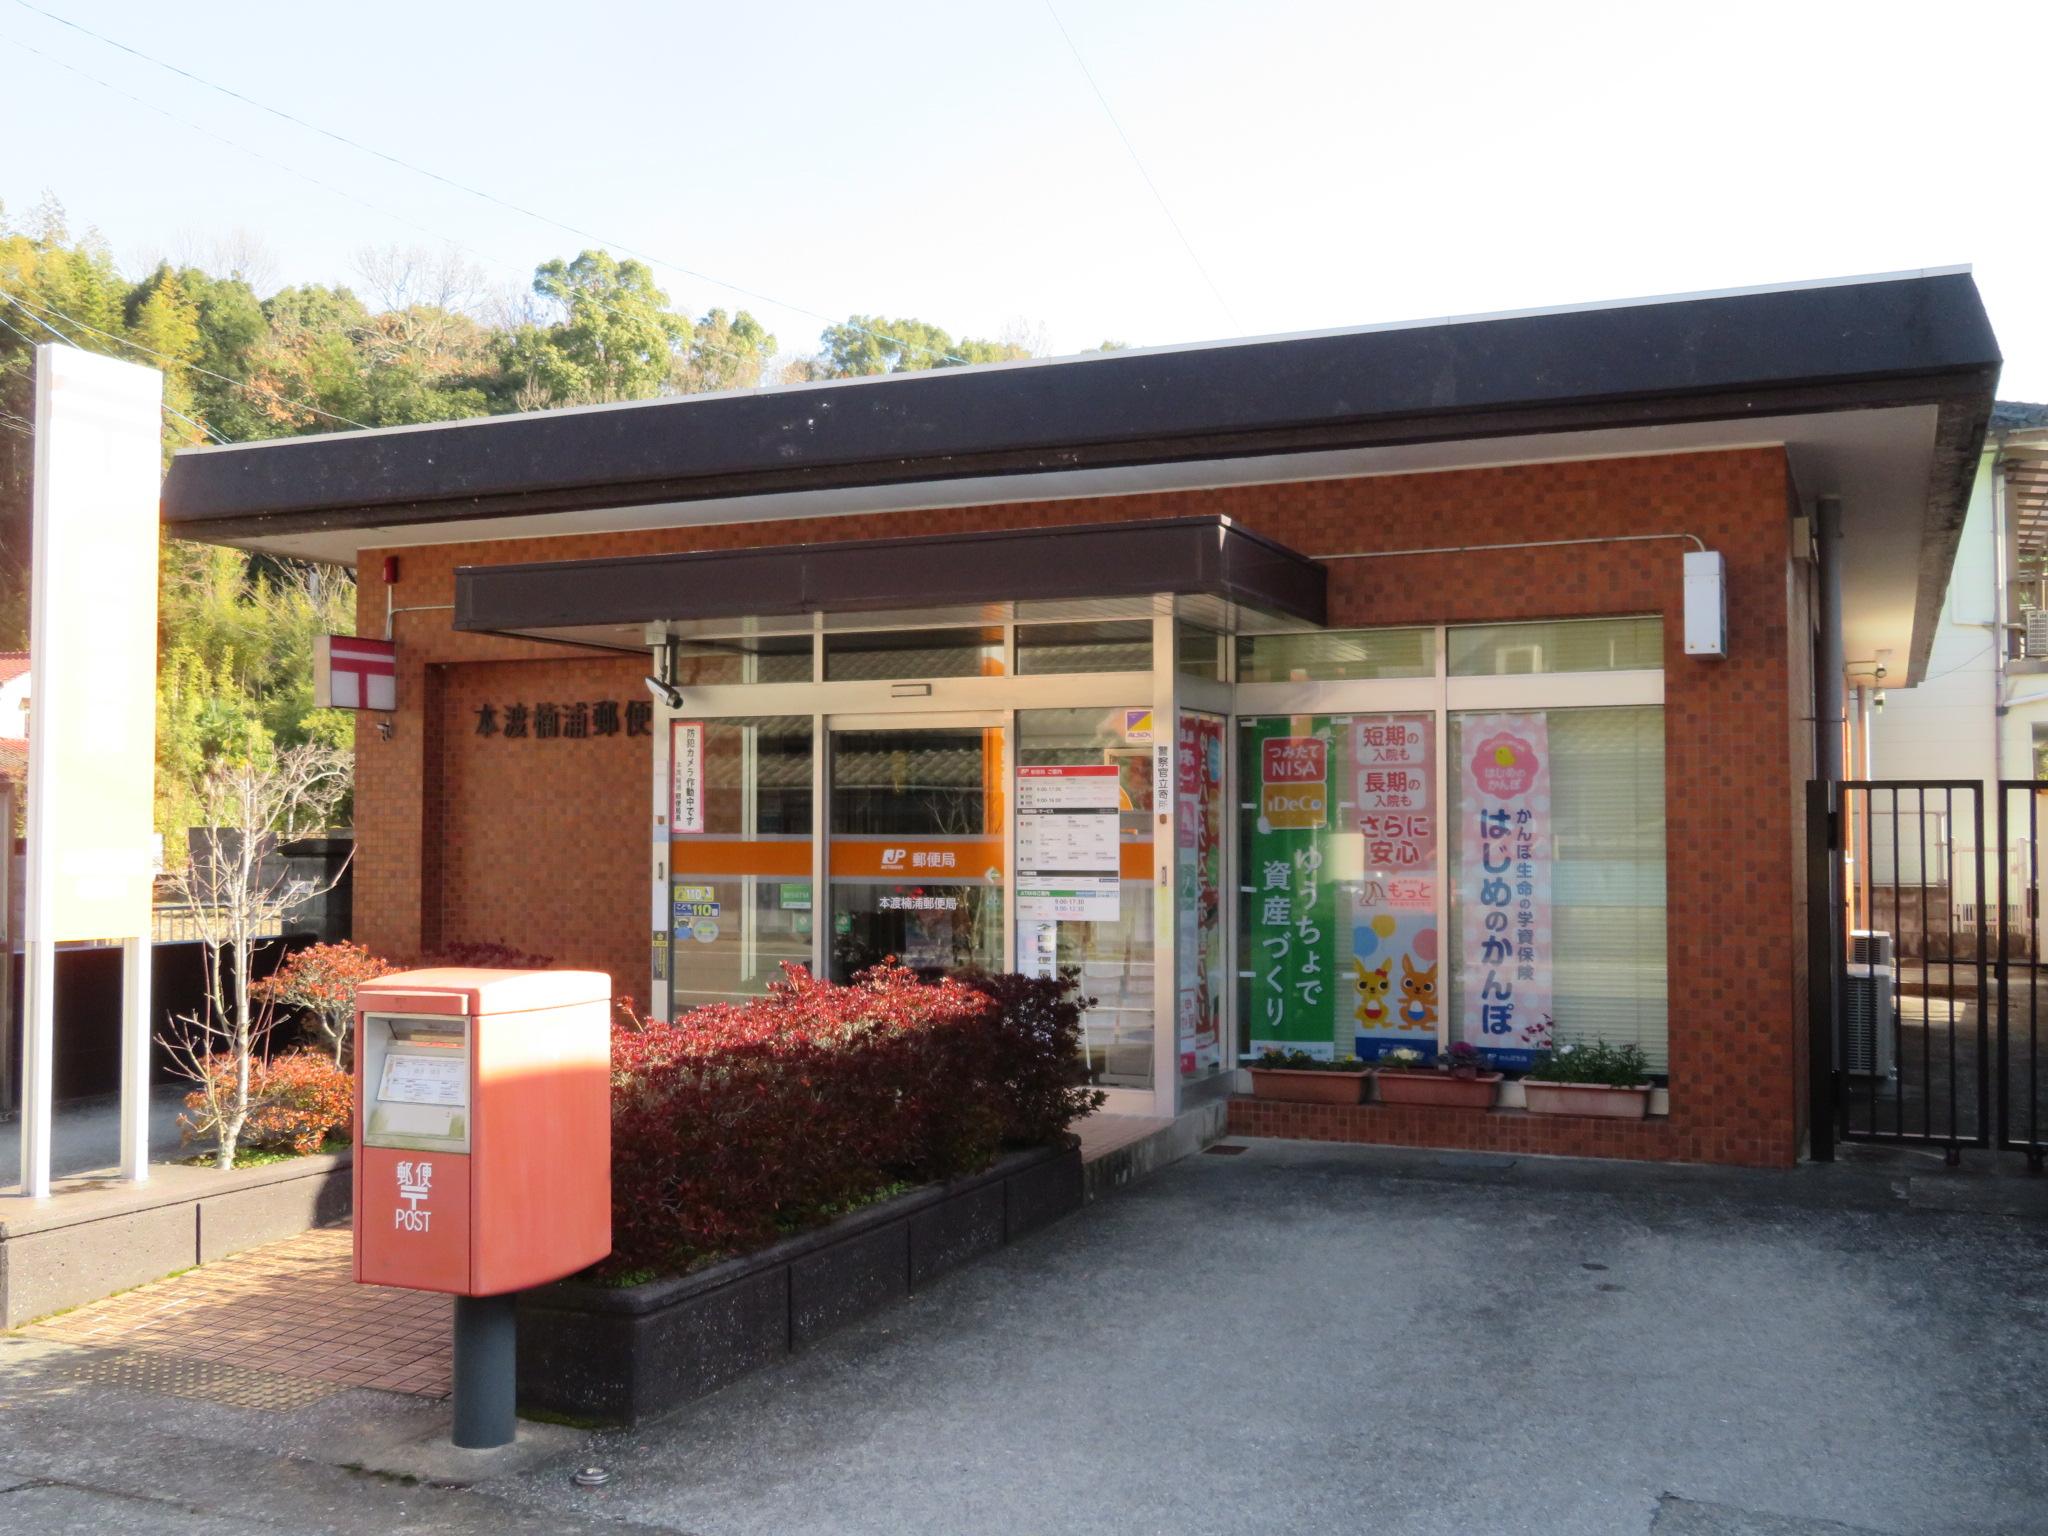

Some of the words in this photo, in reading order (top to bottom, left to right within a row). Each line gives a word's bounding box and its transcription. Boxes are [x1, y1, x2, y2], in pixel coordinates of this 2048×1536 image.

[1363, 725, 1419, 747] 短期の
[1268, 745, 1321, 759] つみたて
[1373, 748, 1410, 761] 入院も
[686, 728, 696, 826] 防犯カメラ作動中です
[1271, 760, 1318, 777] NISA
[1365, 771, 1421, 793] 長期の
[1268, 795, 1322, 813] iDeCo
[1374, 795, 1412, 808] 入院も
[1359, 815, 1429, 839] さらに
[912, 851, 956, 868] 郵便局
[1369, 839, 1420, 865] 安心
[1387, 881, 1432, 899] もっと
[879, 895, 958, 911] 本渡楠浦郵便局
[1295, 845, 1323, 1005] ゆうちょで
[1480, 808, 1514, 1035] はじめのかんぽ
[1261, 860, 1293, 1027] 資産づくり
[396, 1160, 433, 1188] 郵便
[395, 1208, 432, 1233] POST
